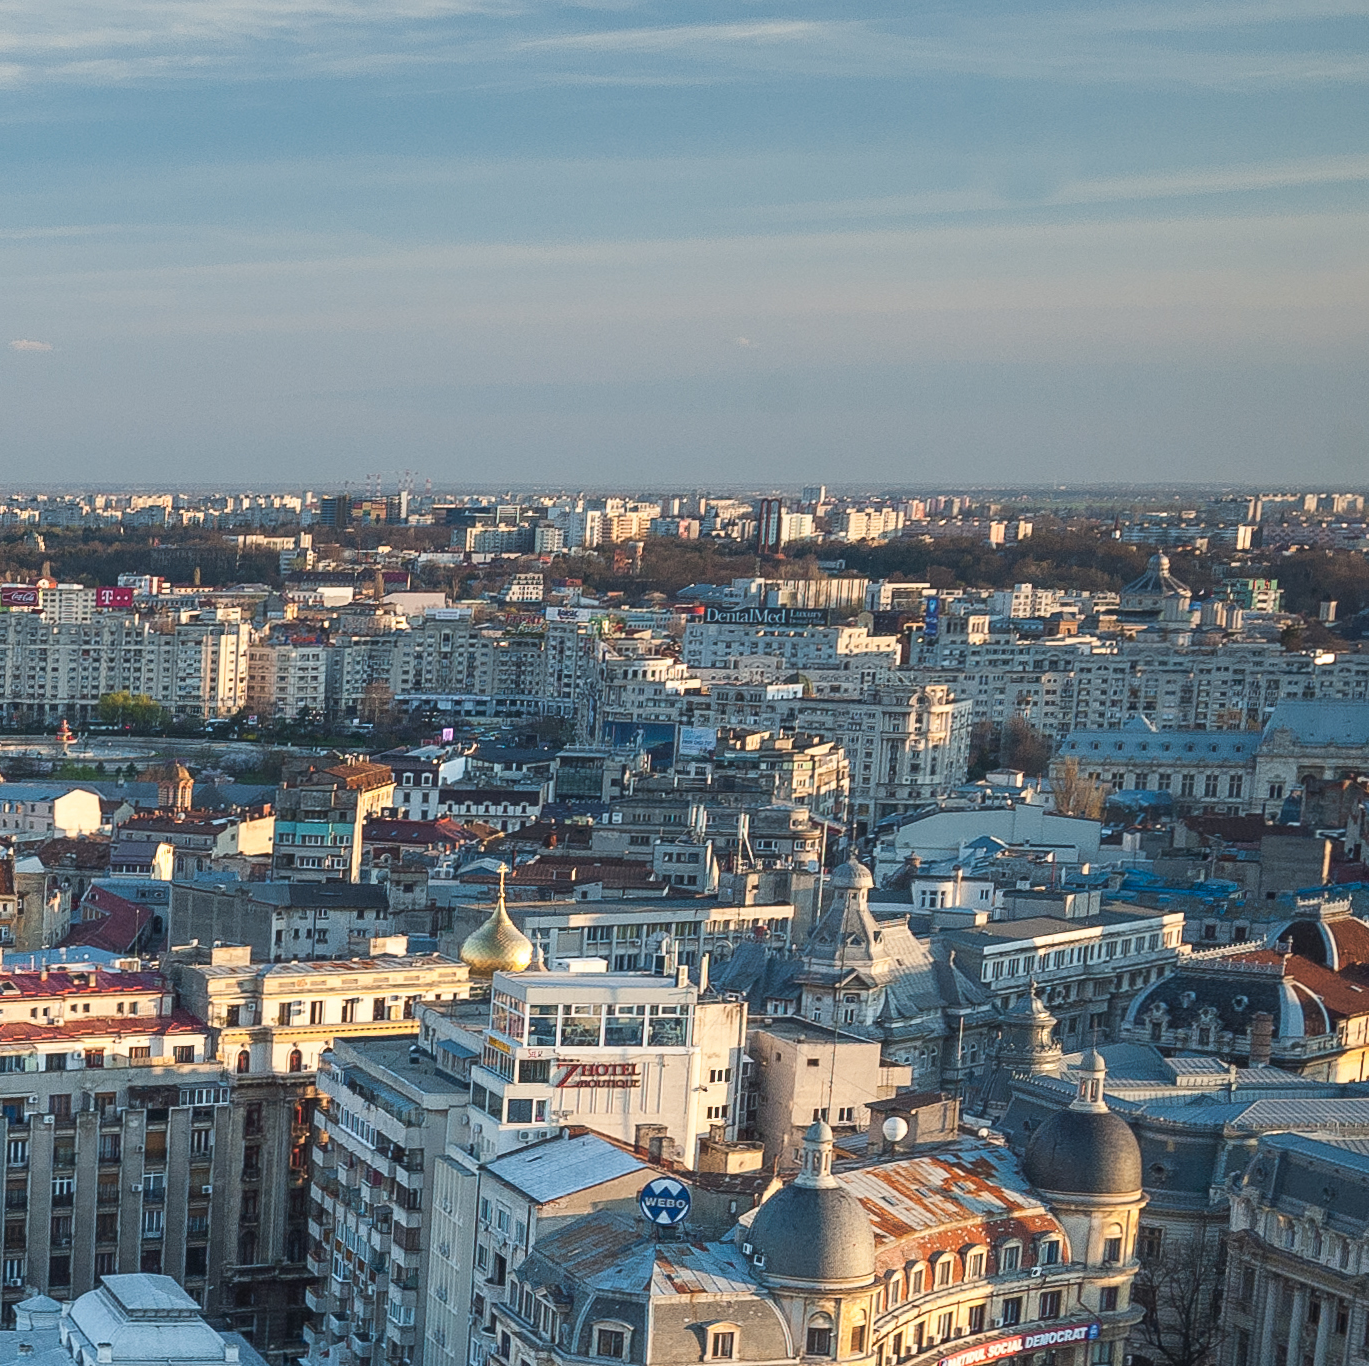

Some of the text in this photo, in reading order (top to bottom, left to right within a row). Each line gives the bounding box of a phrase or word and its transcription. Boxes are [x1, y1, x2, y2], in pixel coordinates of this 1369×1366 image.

[706, 607, 823, 623] DentalMed Luxury
[581, 1063, 641, 1076] HOTEL
[579, 1079, 641, 1089] BOUTIQUE
[644, 1196, 686, 1209] WEBO
[986, 1338, 1023, 1358] SOCIAL
[1025, 1326, 1088, 1349] DEMOCRAT
